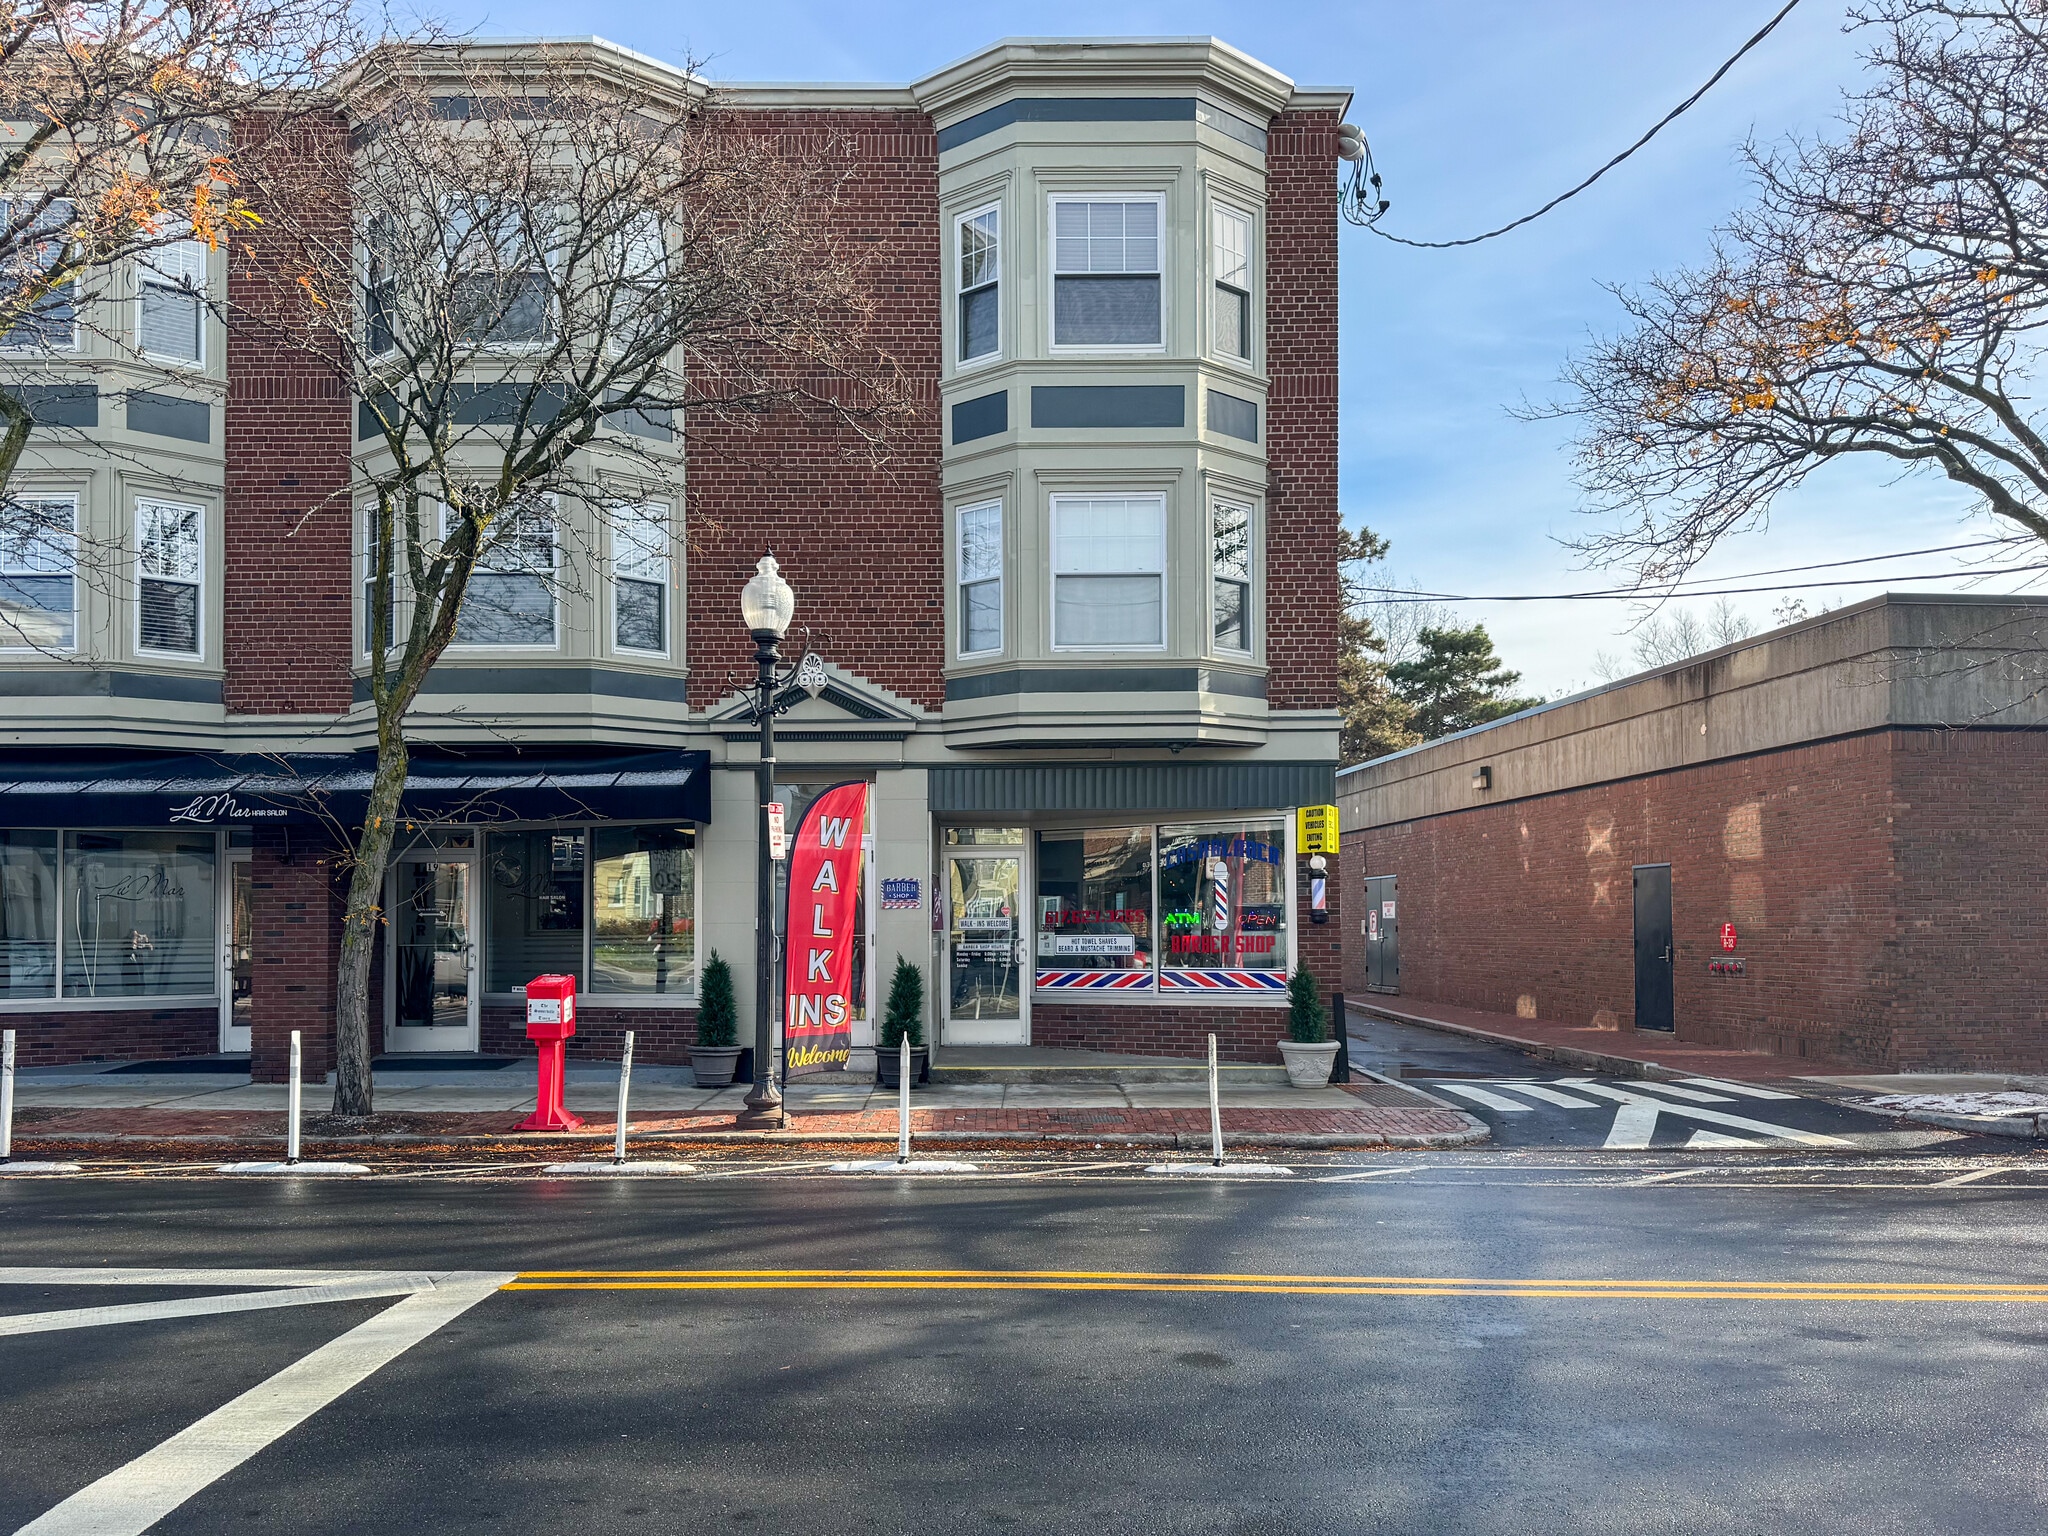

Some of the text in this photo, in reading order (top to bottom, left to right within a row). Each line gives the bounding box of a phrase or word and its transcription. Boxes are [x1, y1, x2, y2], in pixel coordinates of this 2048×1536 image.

[1306, 808, 1323, 817] CAUTION
[1305, 820, 1324, 829] VEHICLES
[1307, 833, 1322, 841] EXITING
[428, 863, 439, 871] 19
[886, 883, 916, 892] BARBER
[807, 815, 851, 982] WALK
[1164, 912, 1200, 924] ATM
[1238, 914, 1276, 925] OPEN
[1725, 923, 1731, 936] F
[1171, 935, 1275, 953] BARBER SHOP
[789, 993, 847, 1027] INS
[787, 1043, 850, 1069] Welcome
